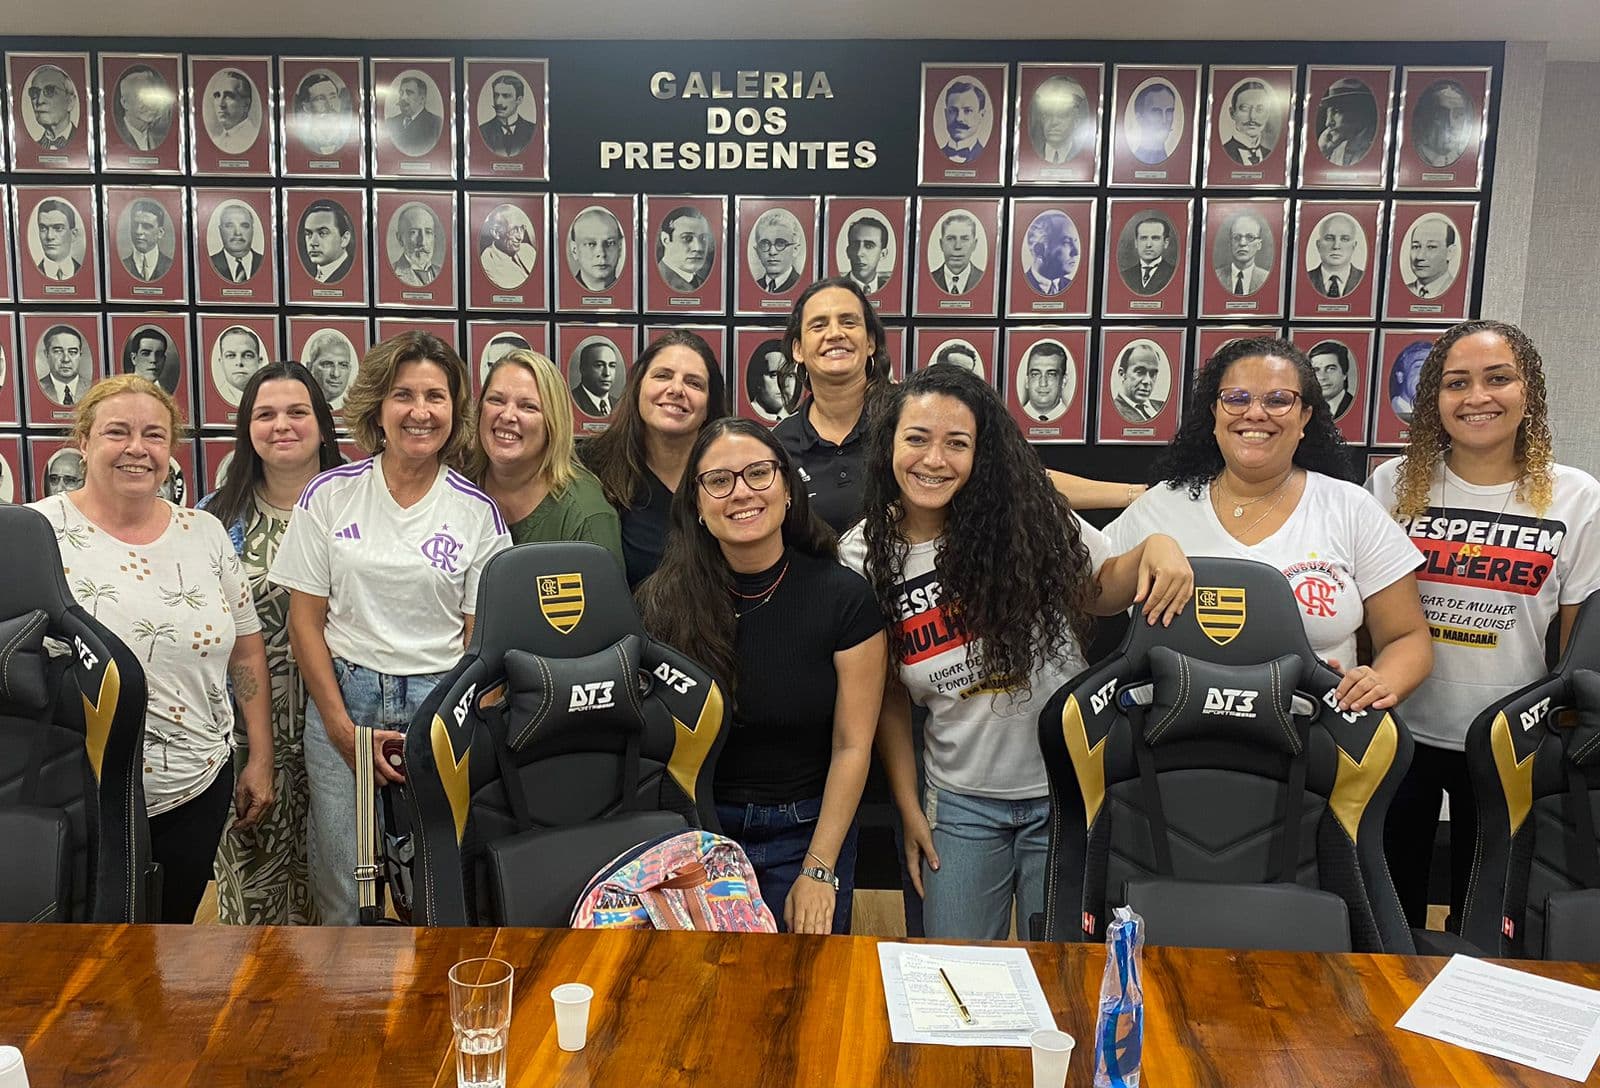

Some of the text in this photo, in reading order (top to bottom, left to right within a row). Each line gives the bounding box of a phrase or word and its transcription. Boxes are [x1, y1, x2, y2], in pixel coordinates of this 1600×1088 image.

[650, 71, 834, 99] GALERIA
[707, 106, 787, 136] DOS
[600, 140, 878, 170] PRESIDENTES
[1458, 543, 1482, 558] AS
[1414, 549, 1548, 588] ULHERES
[1419, 594, 1517, 616] GAR DE MULHER
[1423, 609, 1448, 622] NDE
[1449, 614, 1472, 626] ELA
[1443, 629, 1497, 645] MARACANÃ!
[653, 662, 698, 694] DT3
[929, 662, 965, 683] LUGAR
[945, 673, 976, 692] ONDE
[570, 680, 615, 708] DT3
[1090, 678, 1118, 715] DT3
[1204, 687, 1259, 712] DT3
[1322, 687, 1368, 723] D3
[1519, 696, 1551, 732] DT3
